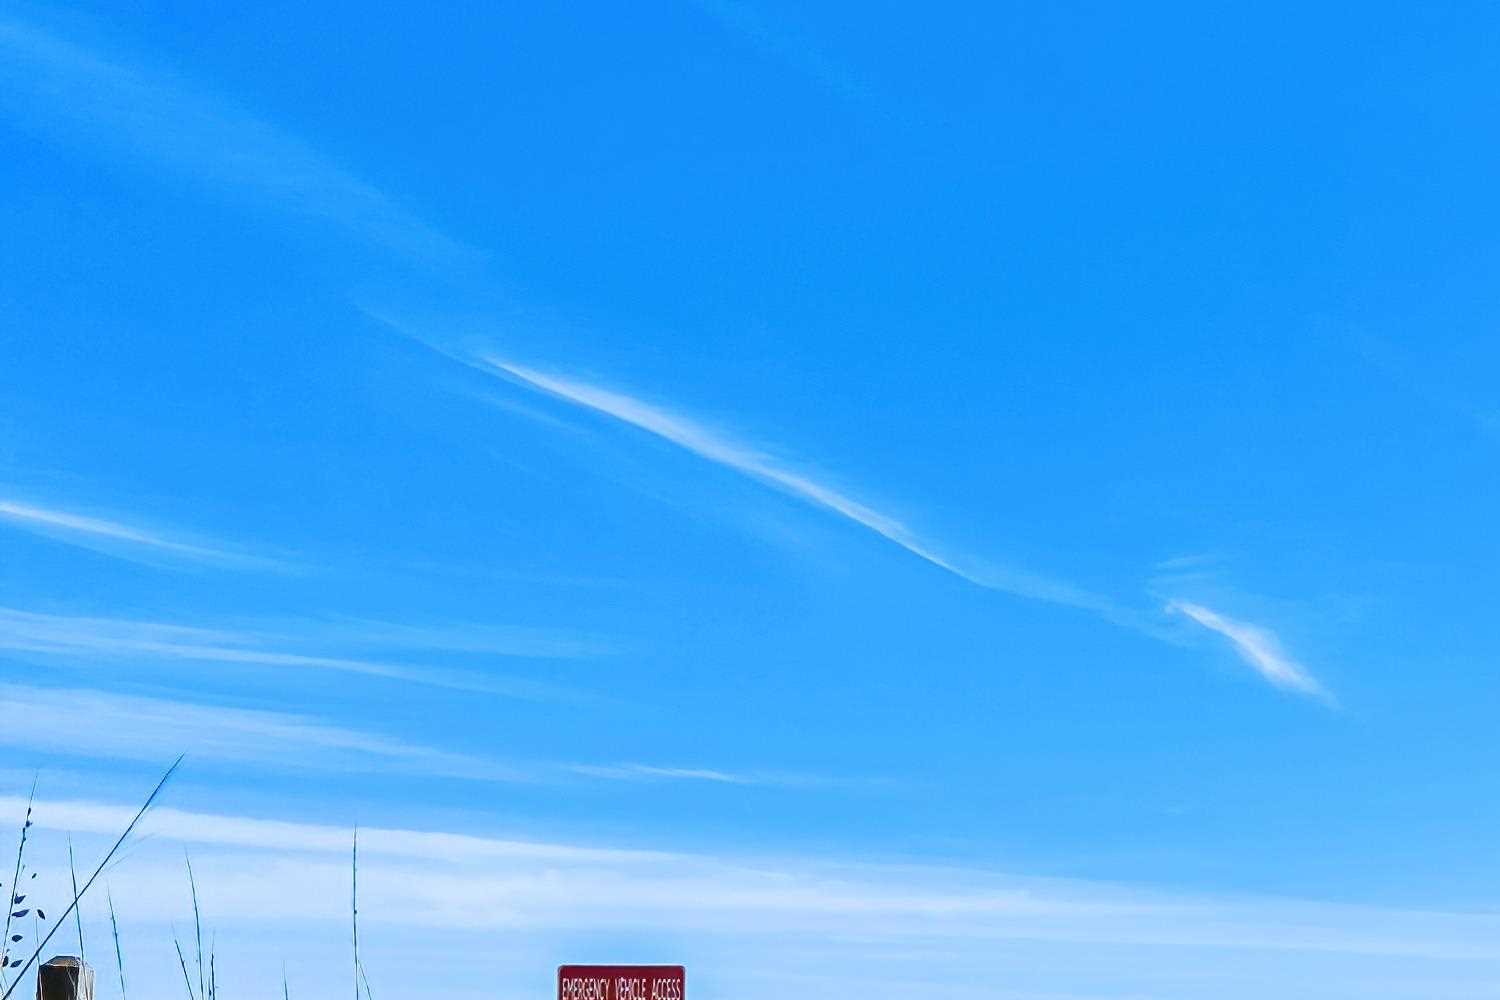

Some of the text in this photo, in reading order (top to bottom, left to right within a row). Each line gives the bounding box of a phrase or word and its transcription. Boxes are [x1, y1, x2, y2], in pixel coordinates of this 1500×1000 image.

[562, 977, 681, 1000] EMERGENCY VEHICLE ACCESS
